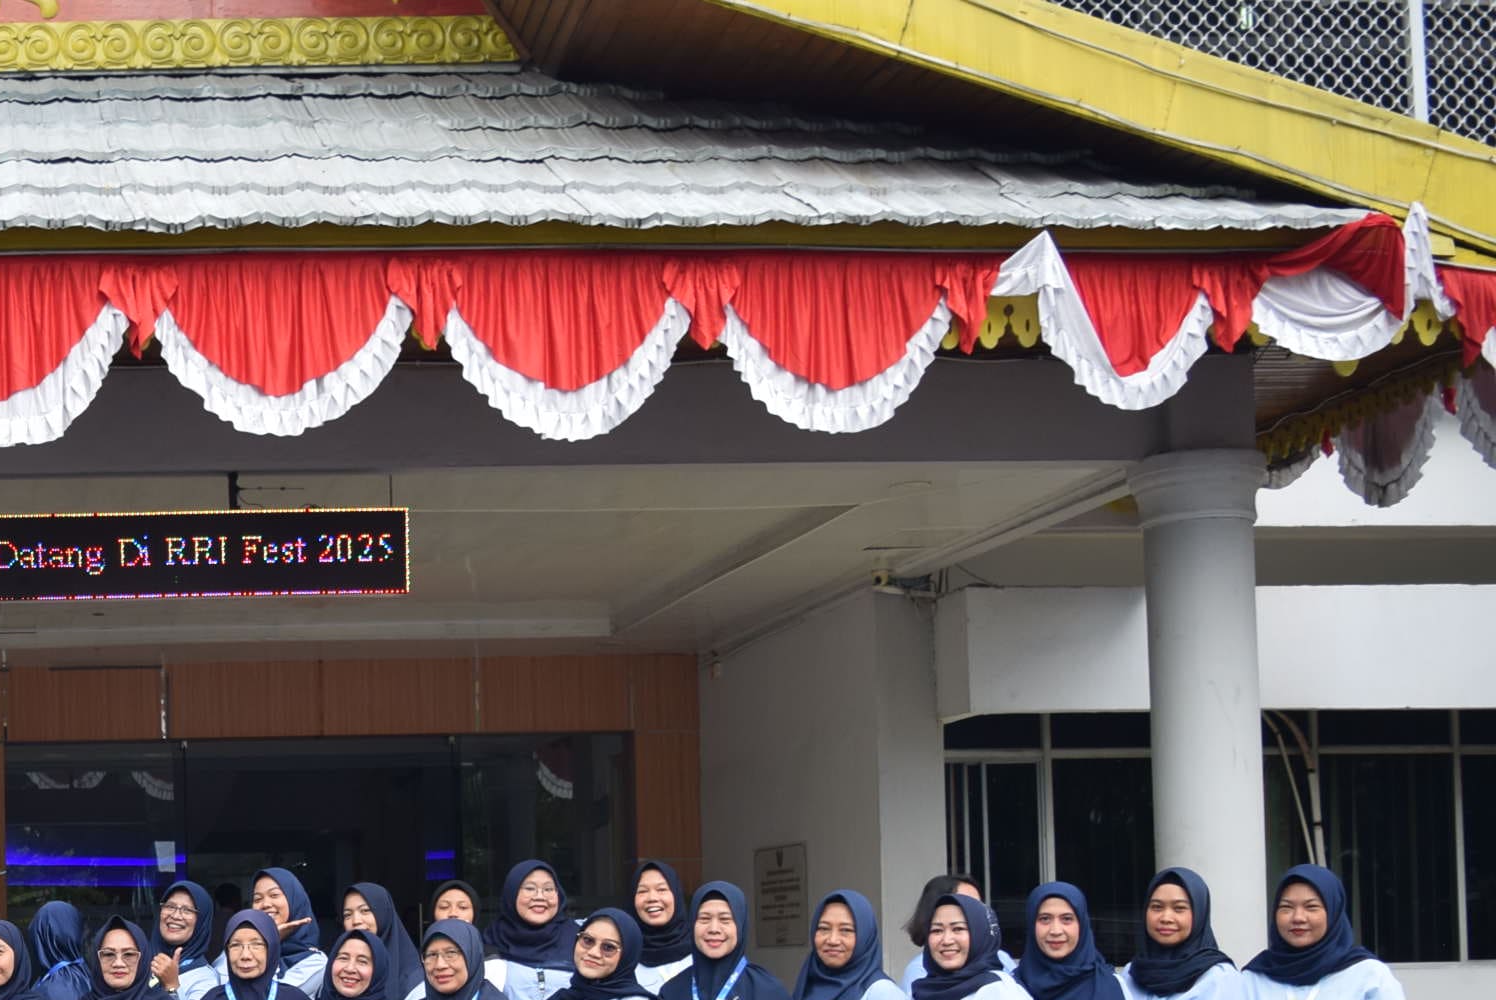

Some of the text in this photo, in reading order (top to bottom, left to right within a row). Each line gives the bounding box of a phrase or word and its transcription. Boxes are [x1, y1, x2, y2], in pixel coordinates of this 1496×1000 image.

[118, 535, 151, 567] Di
[165, 536, 228, 565] RRI
[242, 535, 307, 564] Fest
[319, 534, 394, 563] 2025
